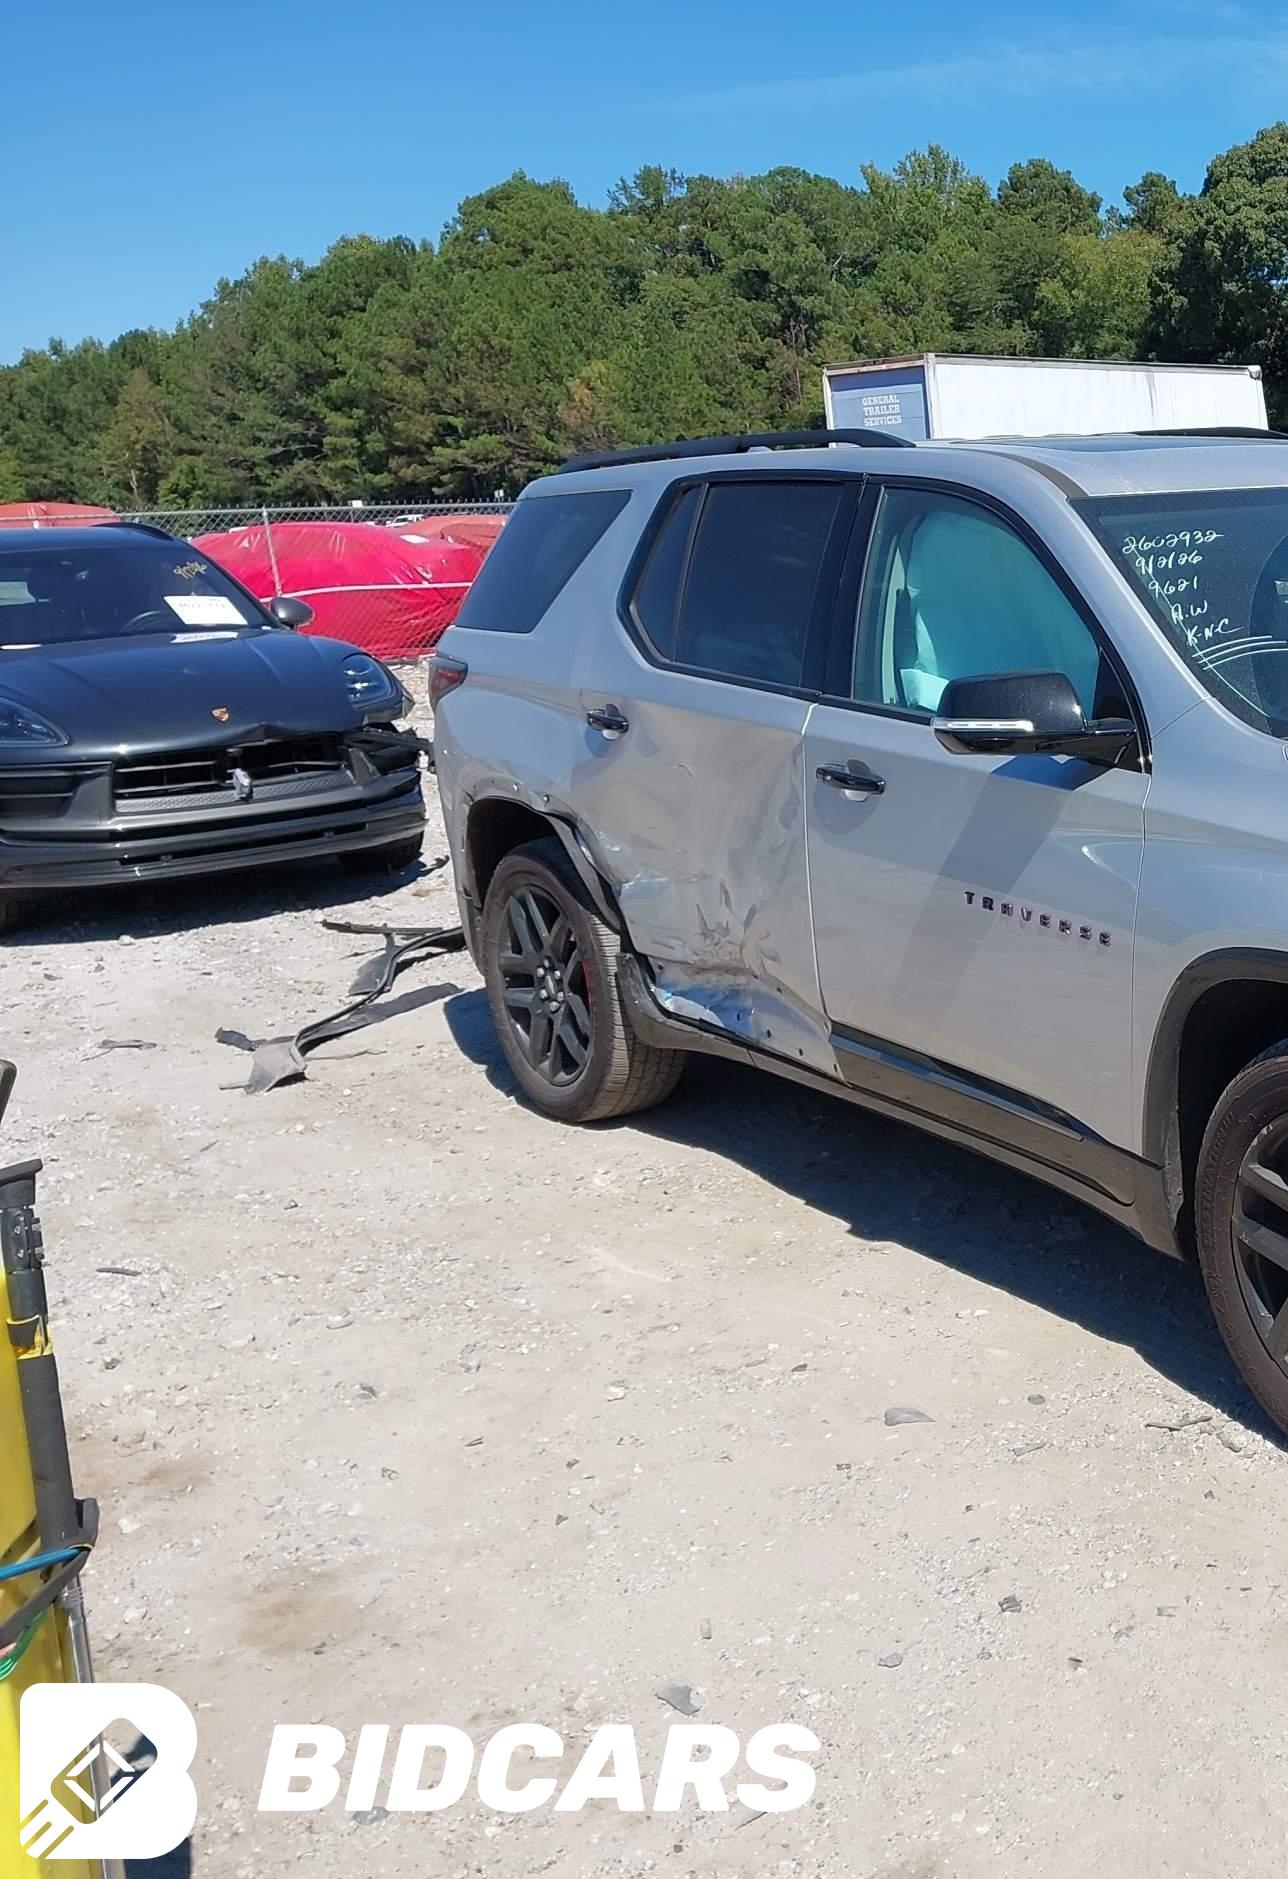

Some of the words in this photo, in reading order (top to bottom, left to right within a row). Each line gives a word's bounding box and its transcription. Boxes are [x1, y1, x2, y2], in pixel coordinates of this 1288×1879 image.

[862, 395, 899, 405] GENERAL
[863, 405, 900, 415] TRAILER
[865, 416, 902, 426] SERVICES
[1122, 530, 1225, 553] 2602932
[1148, 576, 1198, 599] 9621
[964, 891, 1111, 947] TRAVERSE
